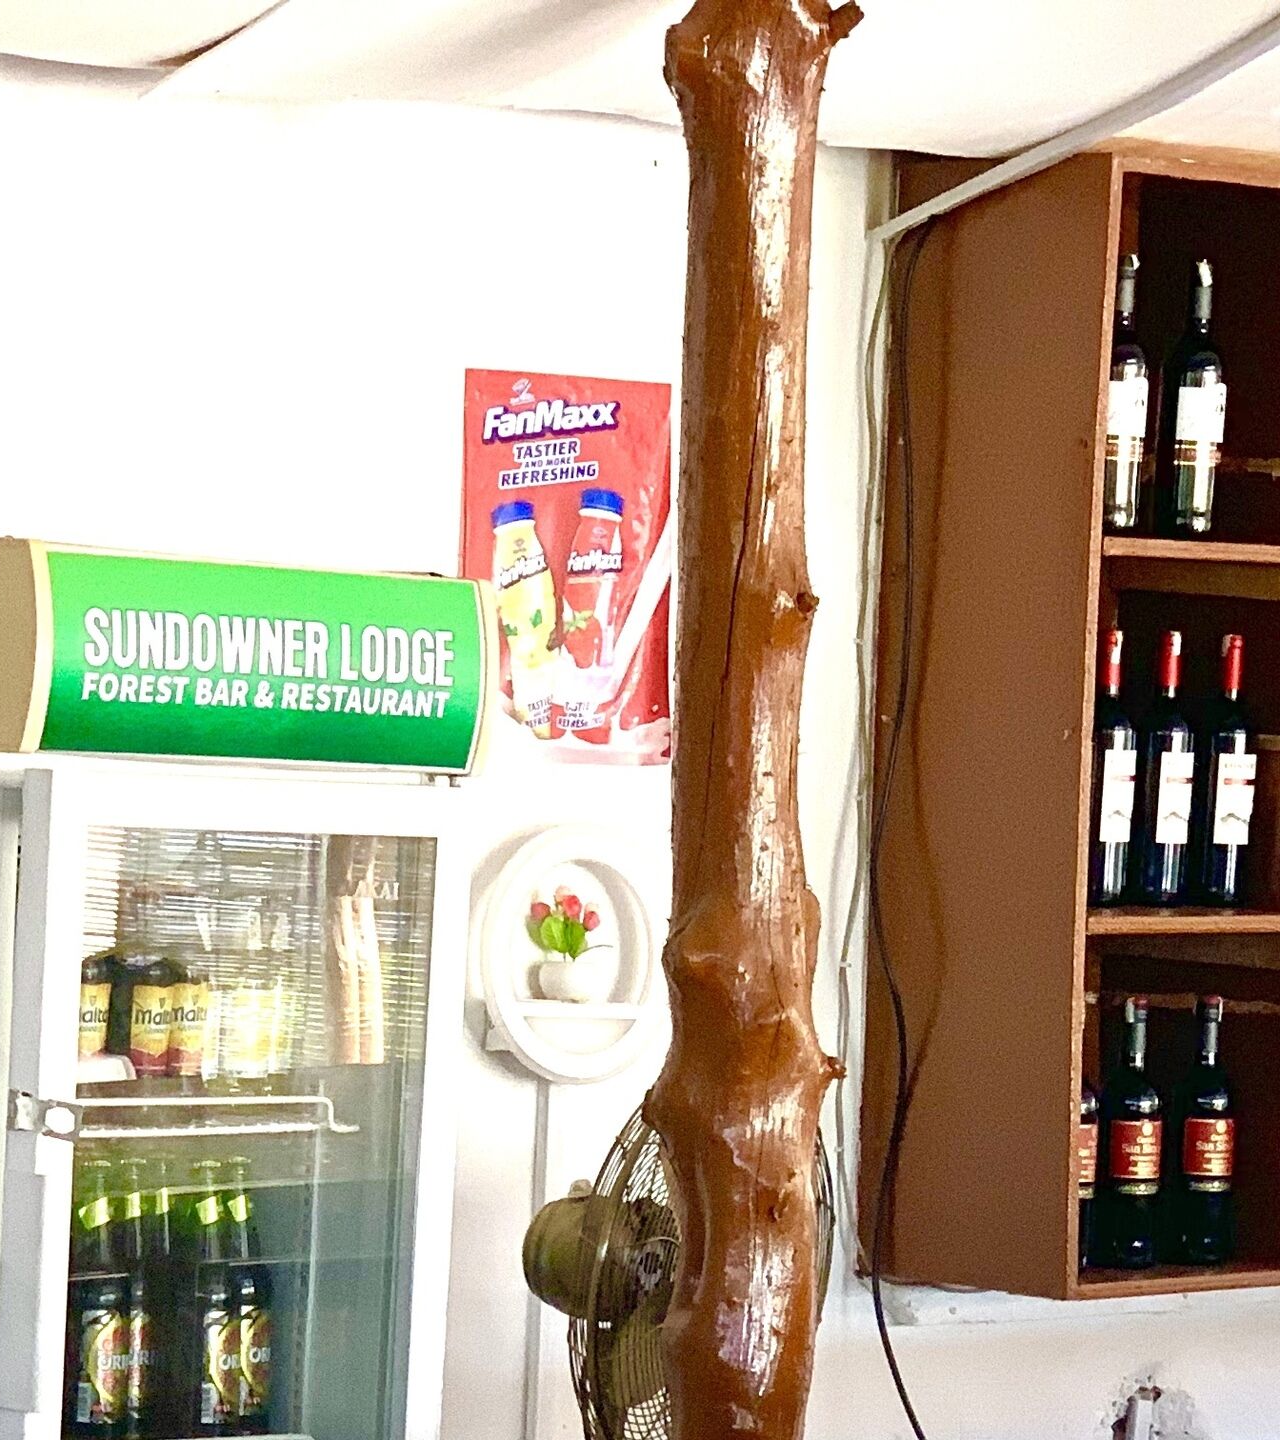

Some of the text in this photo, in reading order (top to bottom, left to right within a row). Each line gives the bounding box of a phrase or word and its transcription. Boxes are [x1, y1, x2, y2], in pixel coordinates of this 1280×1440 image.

[482, 399, 619, 443] FanMaxx
[516, 441, 578, 460] TASTIER
[524, 456, 571, 469] AND MORE
[501, 464, 596, 487] REFRESHING
[83, 607, 455, 687] SUNDOWNER LODGE
[81, 672, 451, 720] FOREST BAR & RESTAURANT
